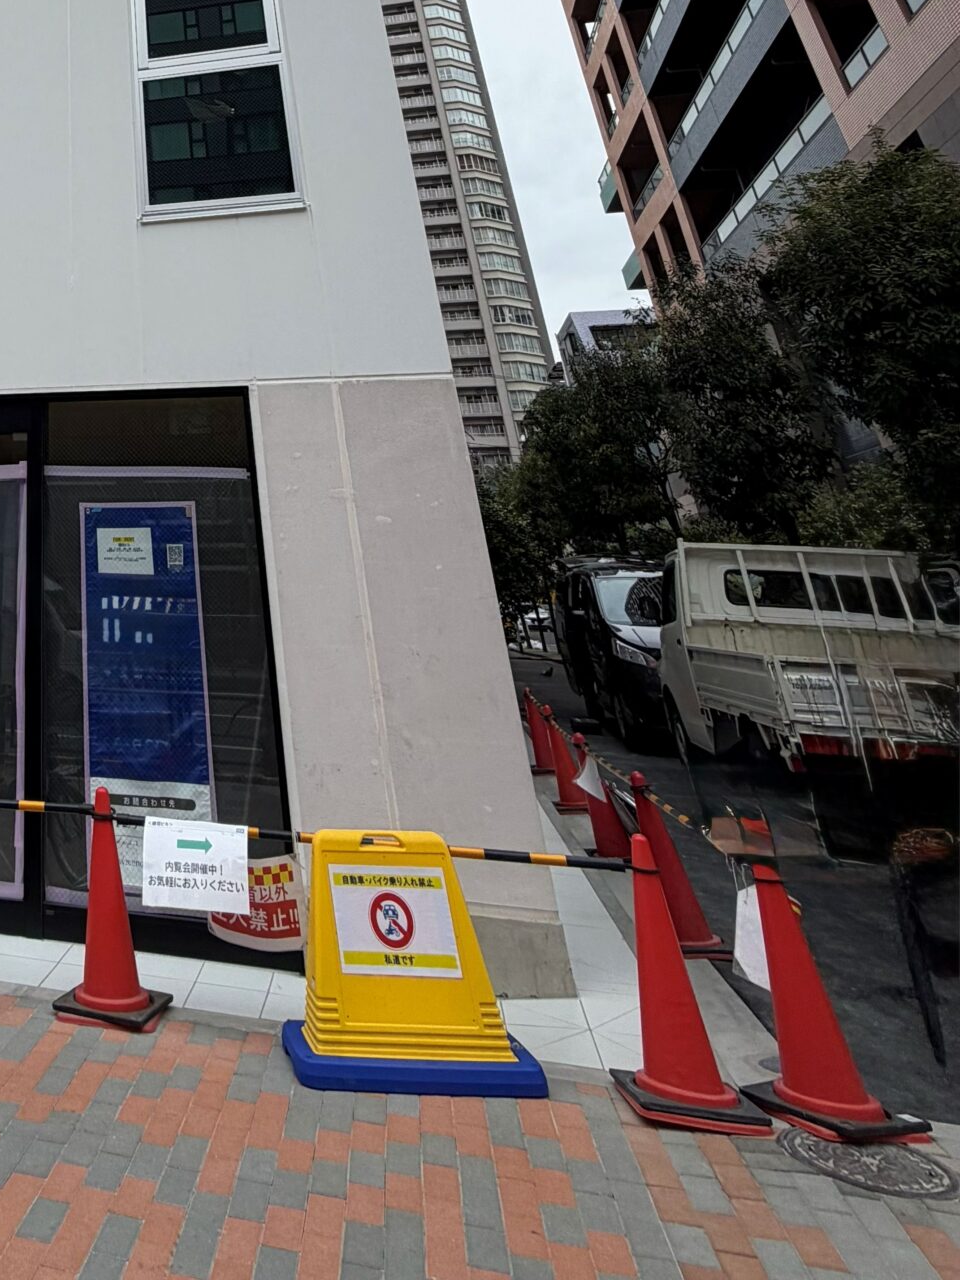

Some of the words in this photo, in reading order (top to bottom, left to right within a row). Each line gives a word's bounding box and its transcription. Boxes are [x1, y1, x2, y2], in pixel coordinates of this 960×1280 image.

[165, 861, 224, 876] 内覧会開催中！
[148, 875, 245, 893] お気軽にお入りください
[342, 875, 435, 888] 自動車・バイク乗り入れ禁止
[384, 954, 416, 966] 私道です
